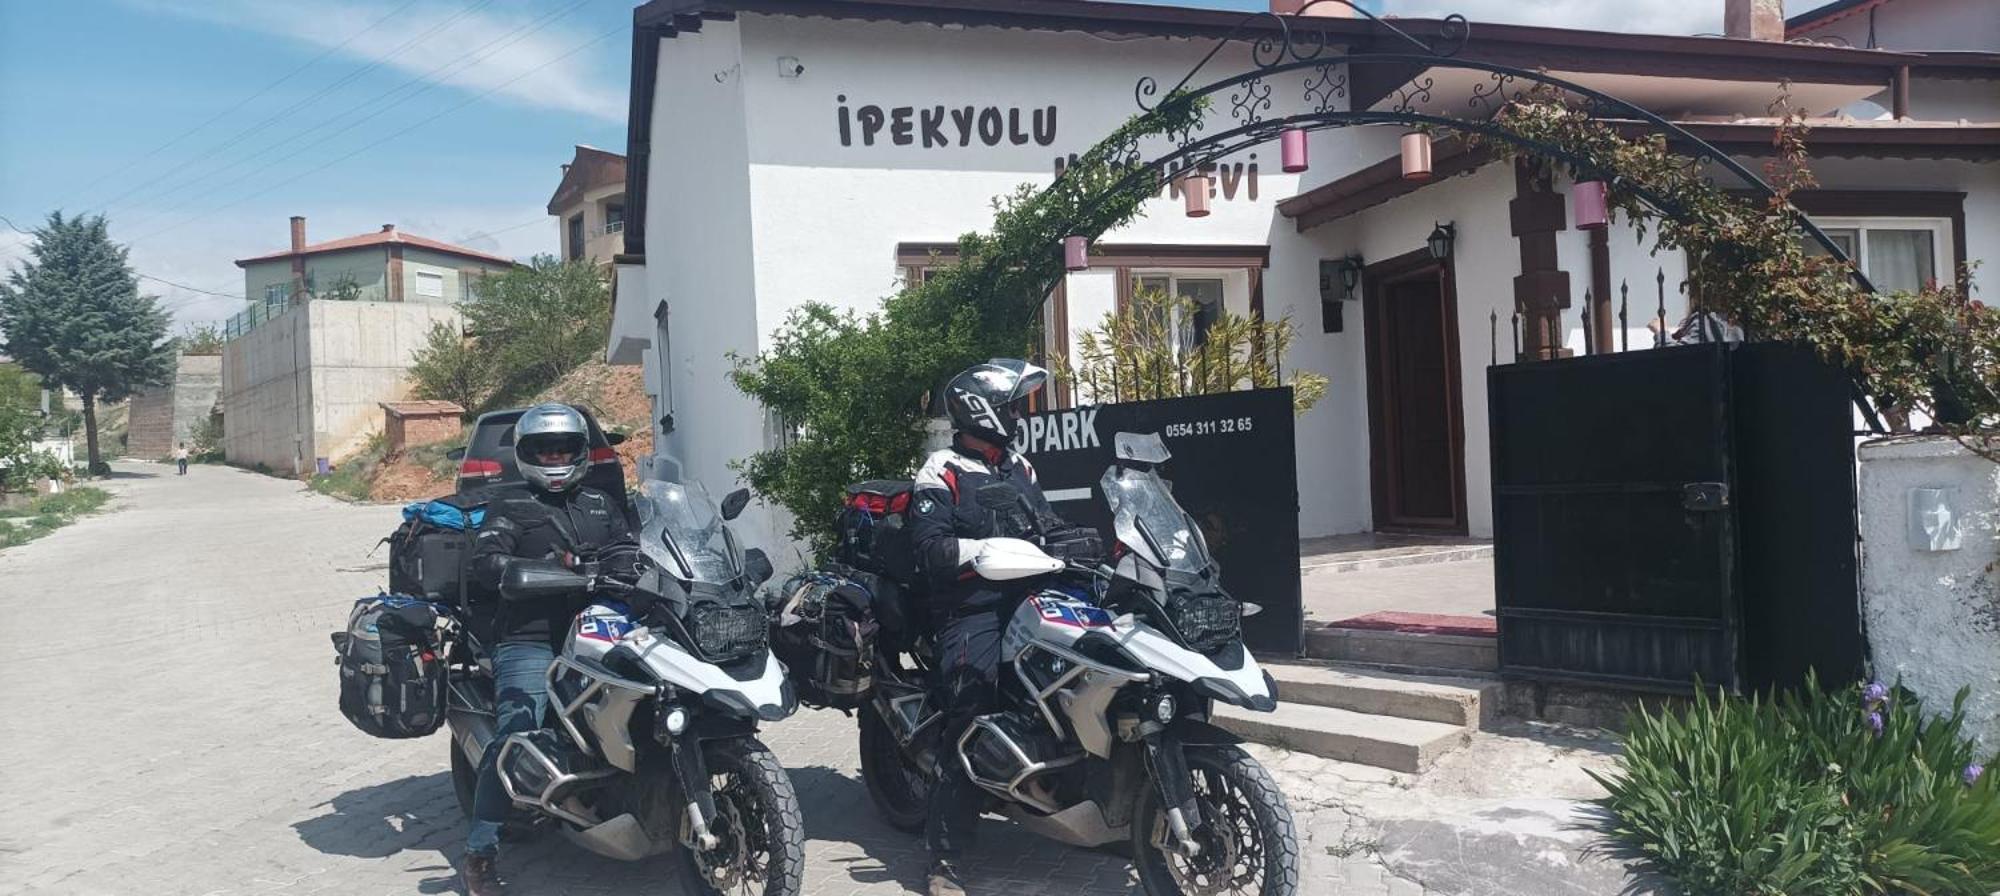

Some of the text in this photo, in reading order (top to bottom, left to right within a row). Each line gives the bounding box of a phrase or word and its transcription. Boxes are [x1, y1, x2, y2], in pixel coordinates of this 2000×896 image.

[837, 94, 1057, 148] İPEKYOLU
[1165, 416, 1252, 438] 0554 311 32 65
